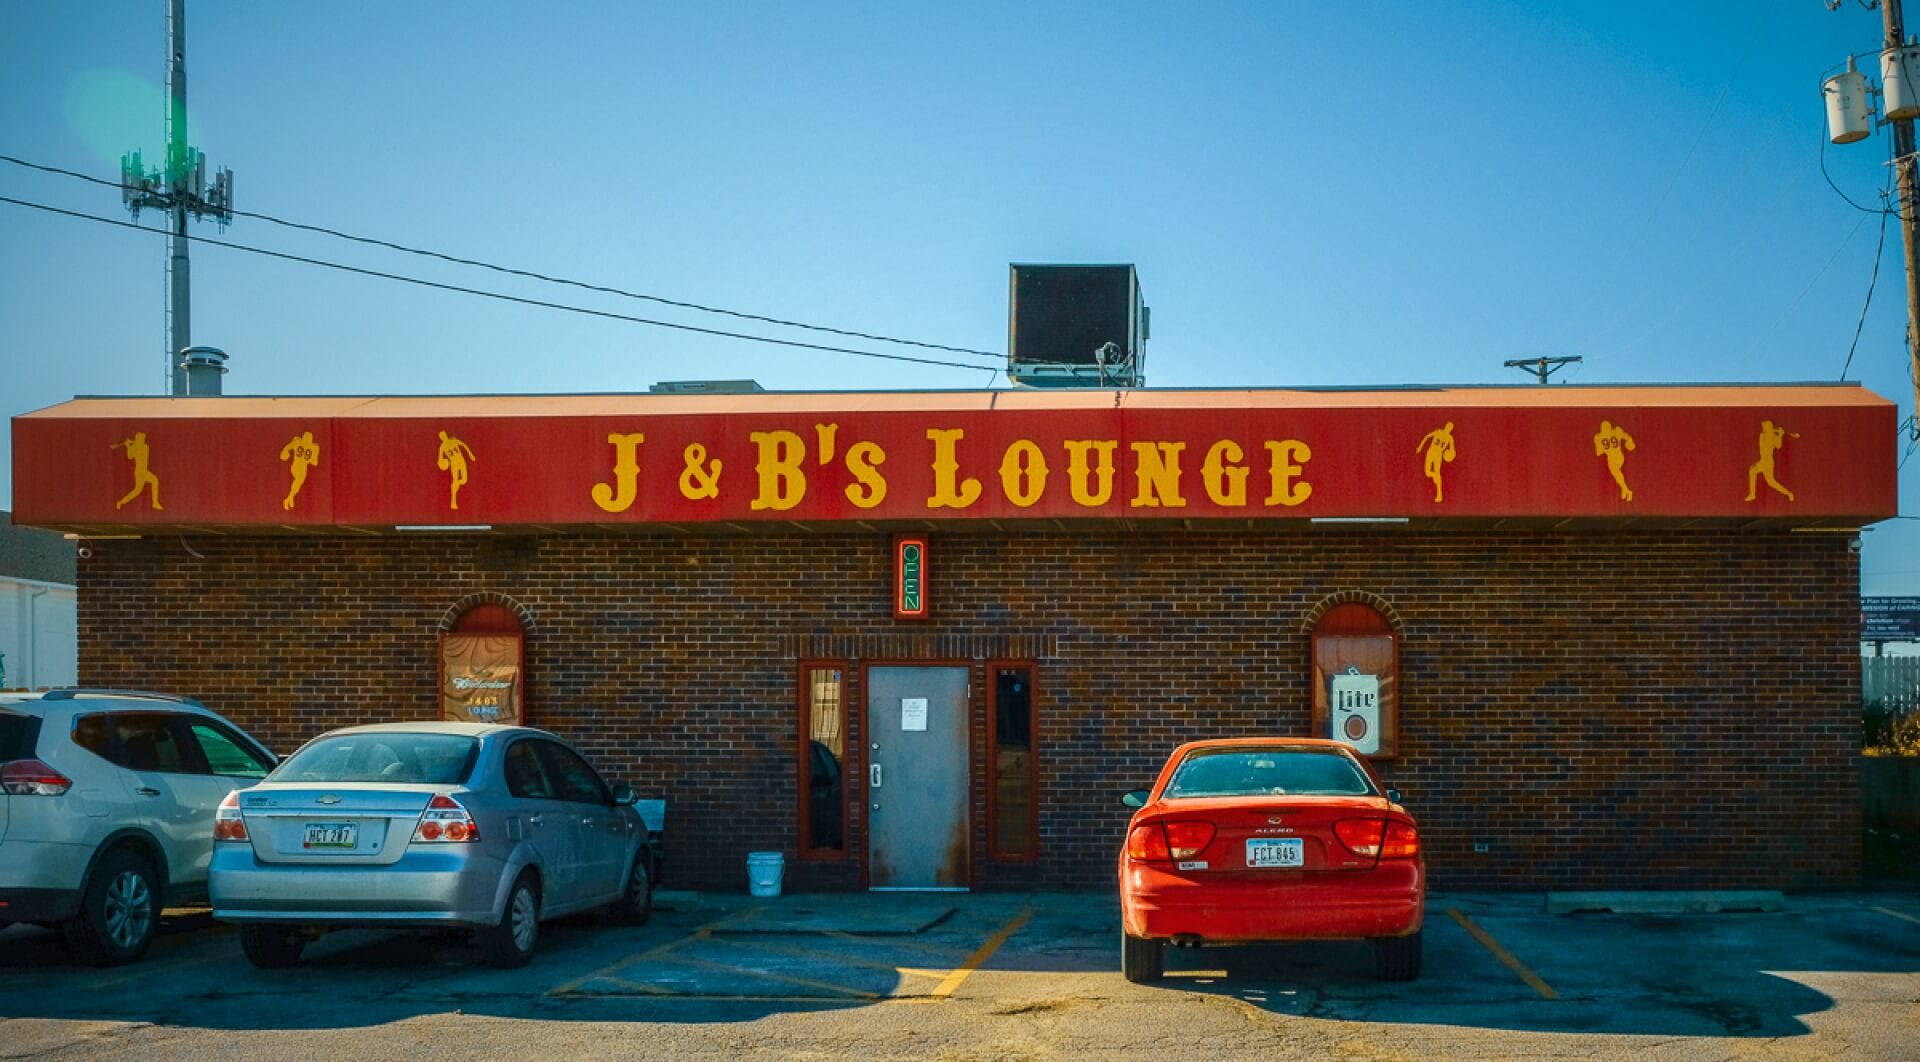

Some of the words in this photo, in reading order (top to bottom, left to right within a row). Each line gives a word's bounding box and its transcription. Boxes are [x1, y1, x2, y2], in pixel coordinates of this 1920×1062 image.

[591, 432, 645, 513] J
[679, 442, 723, 501] &
[926, 428, 1313, 508] LOUNGE
[903, 545, 920, 610] OPEN
[1336, 689, 1376, 713] Lite
[1253, 847, 1273, 861] ECT
